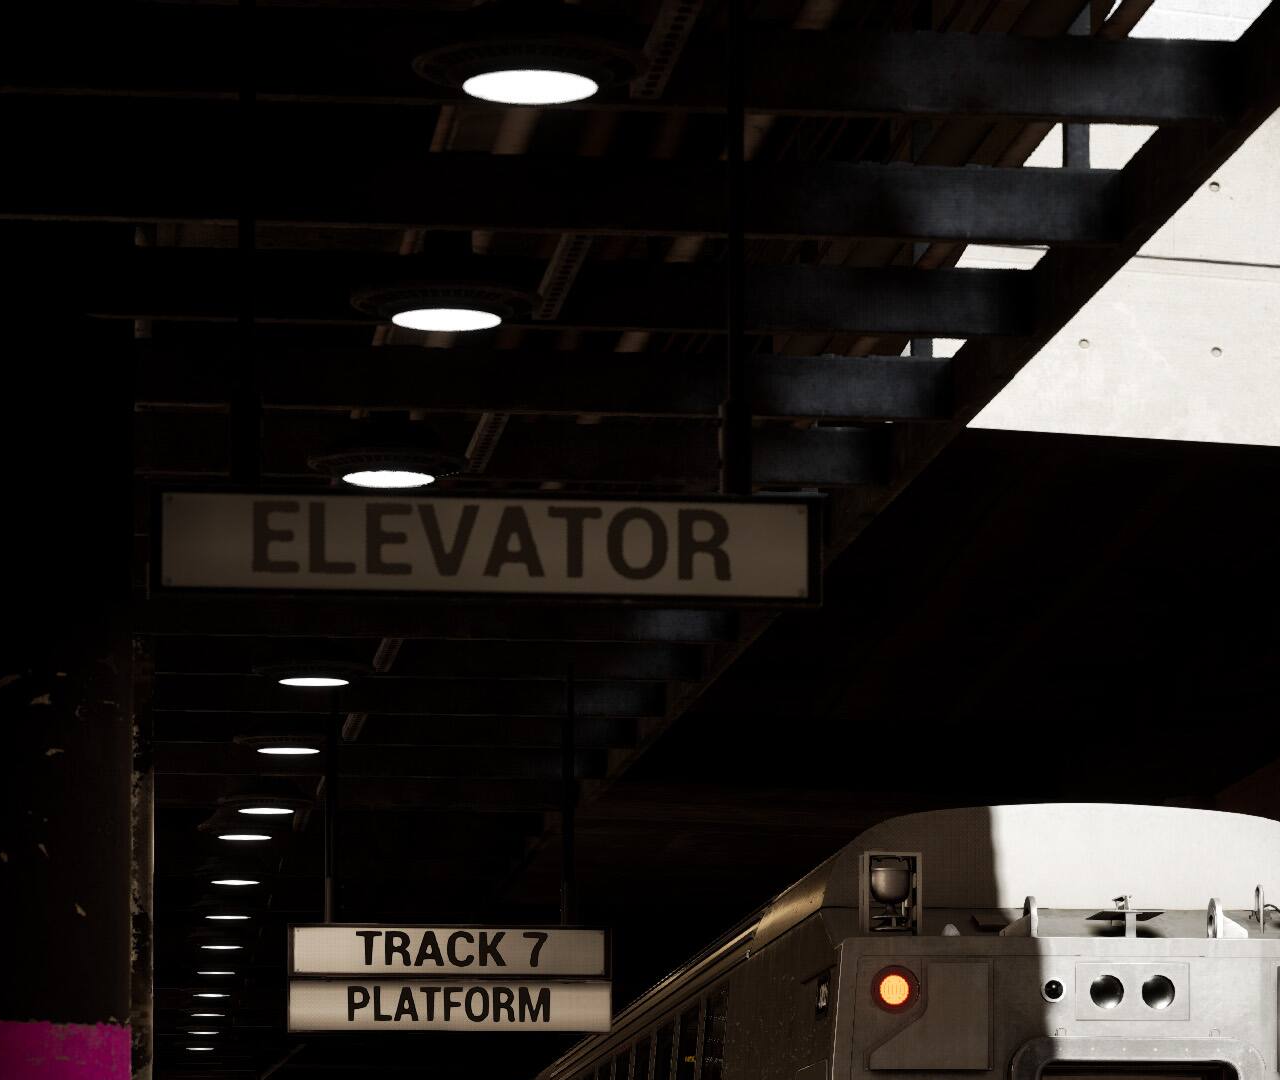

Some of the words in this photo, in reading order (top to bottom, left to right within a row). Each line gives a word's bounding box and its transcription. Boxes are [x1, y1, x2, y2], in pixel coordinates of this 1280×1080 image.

[252, 501, 732, 581] ELEVATOR
[356, 931, 506, 967] TRACK
[523, 932, 548, 967] 7
[347, 986, 551, 1022] PLATFORM
